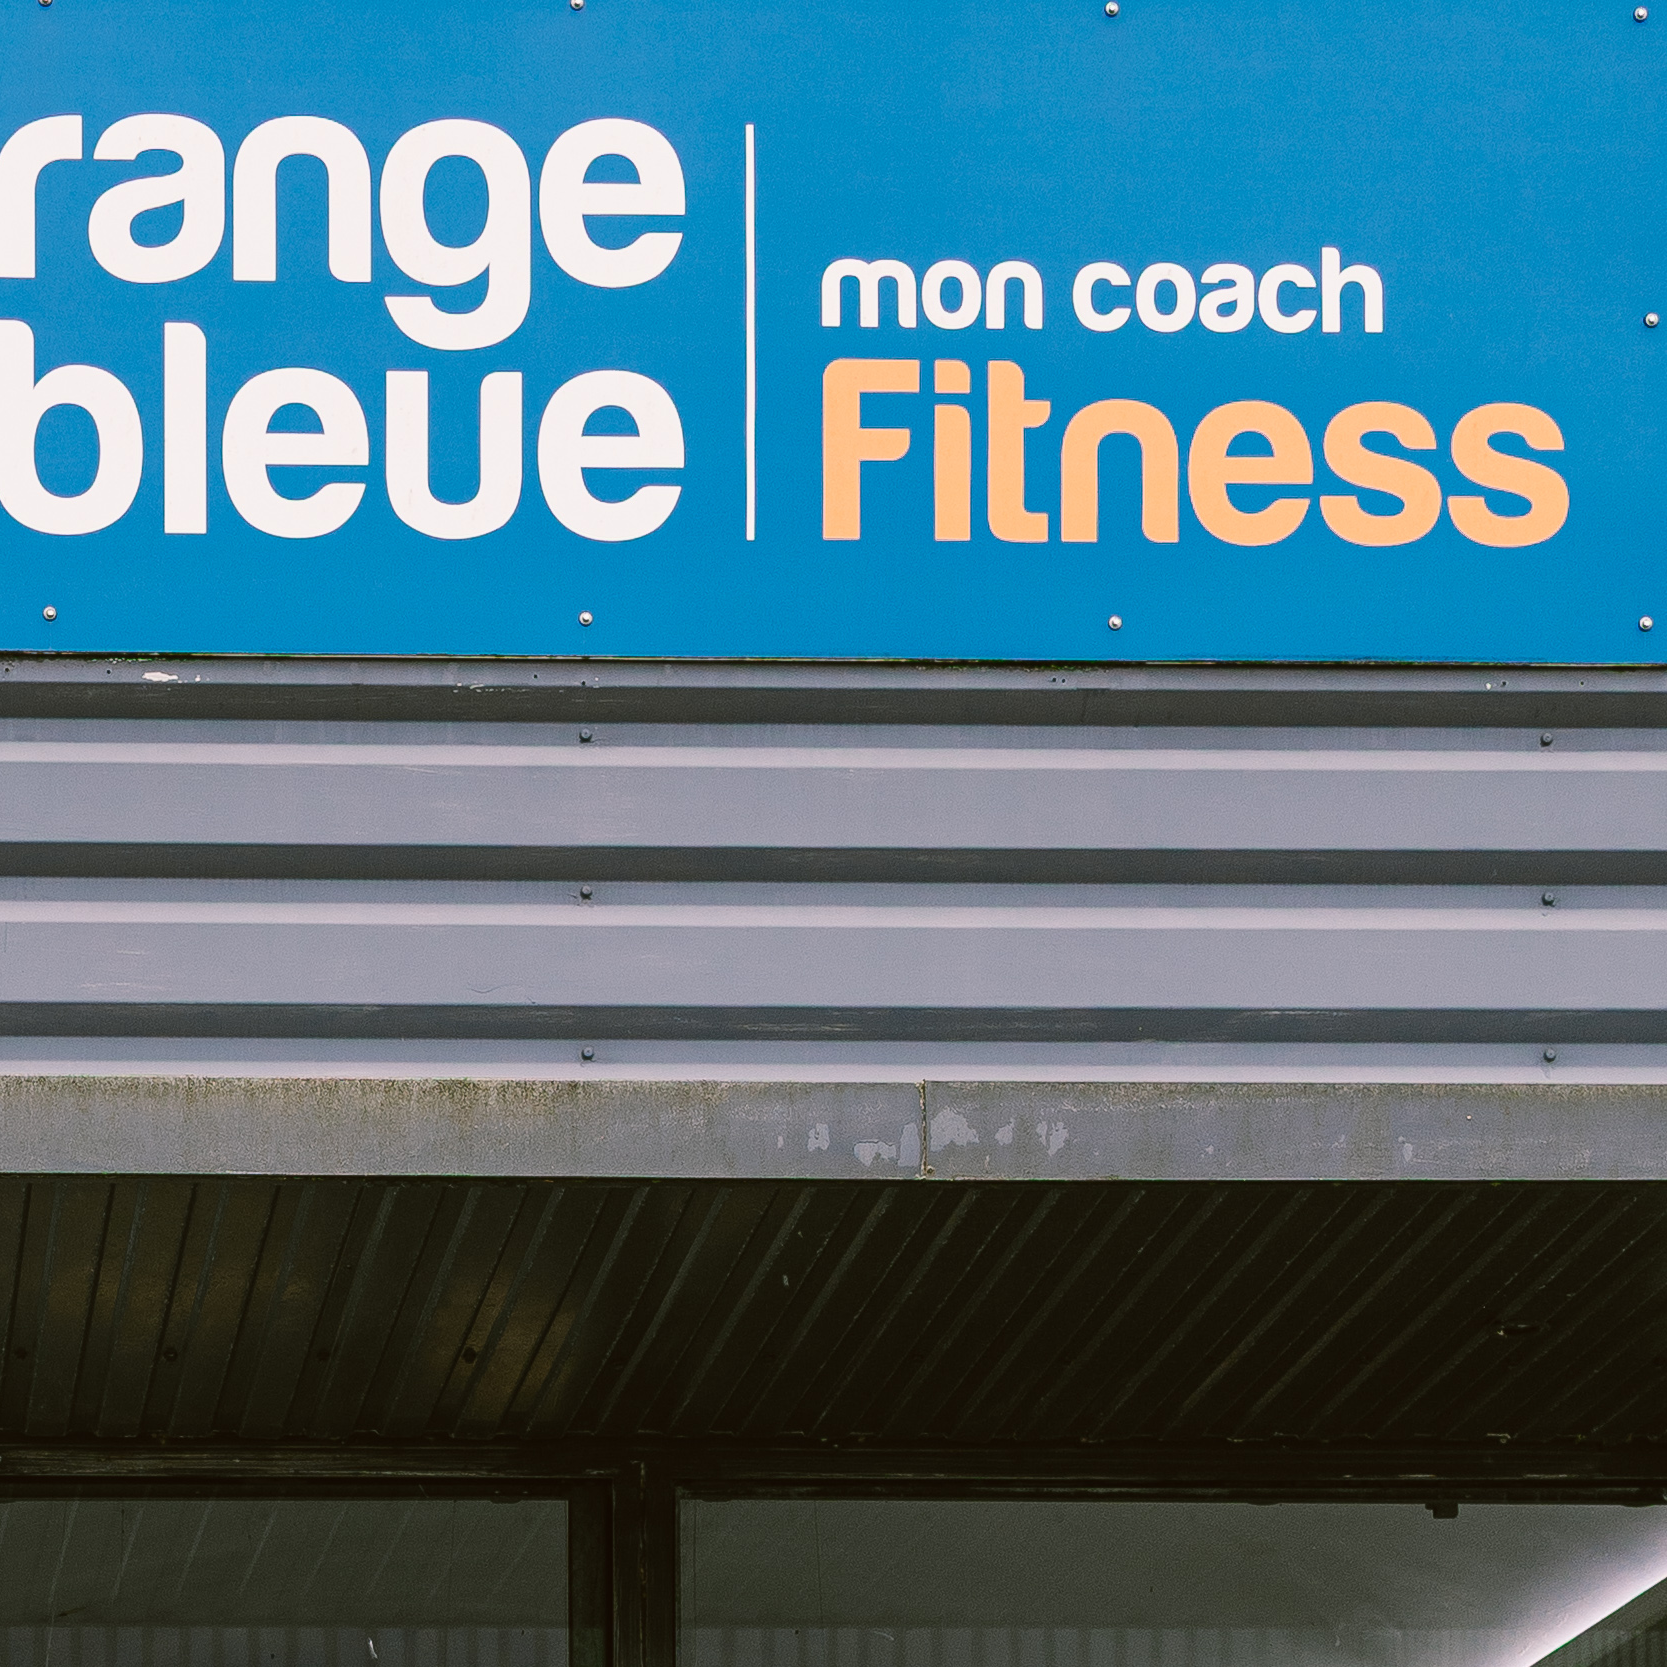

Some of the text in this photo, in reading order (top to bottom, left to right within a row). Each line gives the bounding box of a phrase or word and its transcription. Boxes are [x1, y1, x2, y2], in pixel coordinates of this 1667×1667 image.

[821, 248, 1383, 333] mon coach
[822, 358, 1571, 548] Fitness
